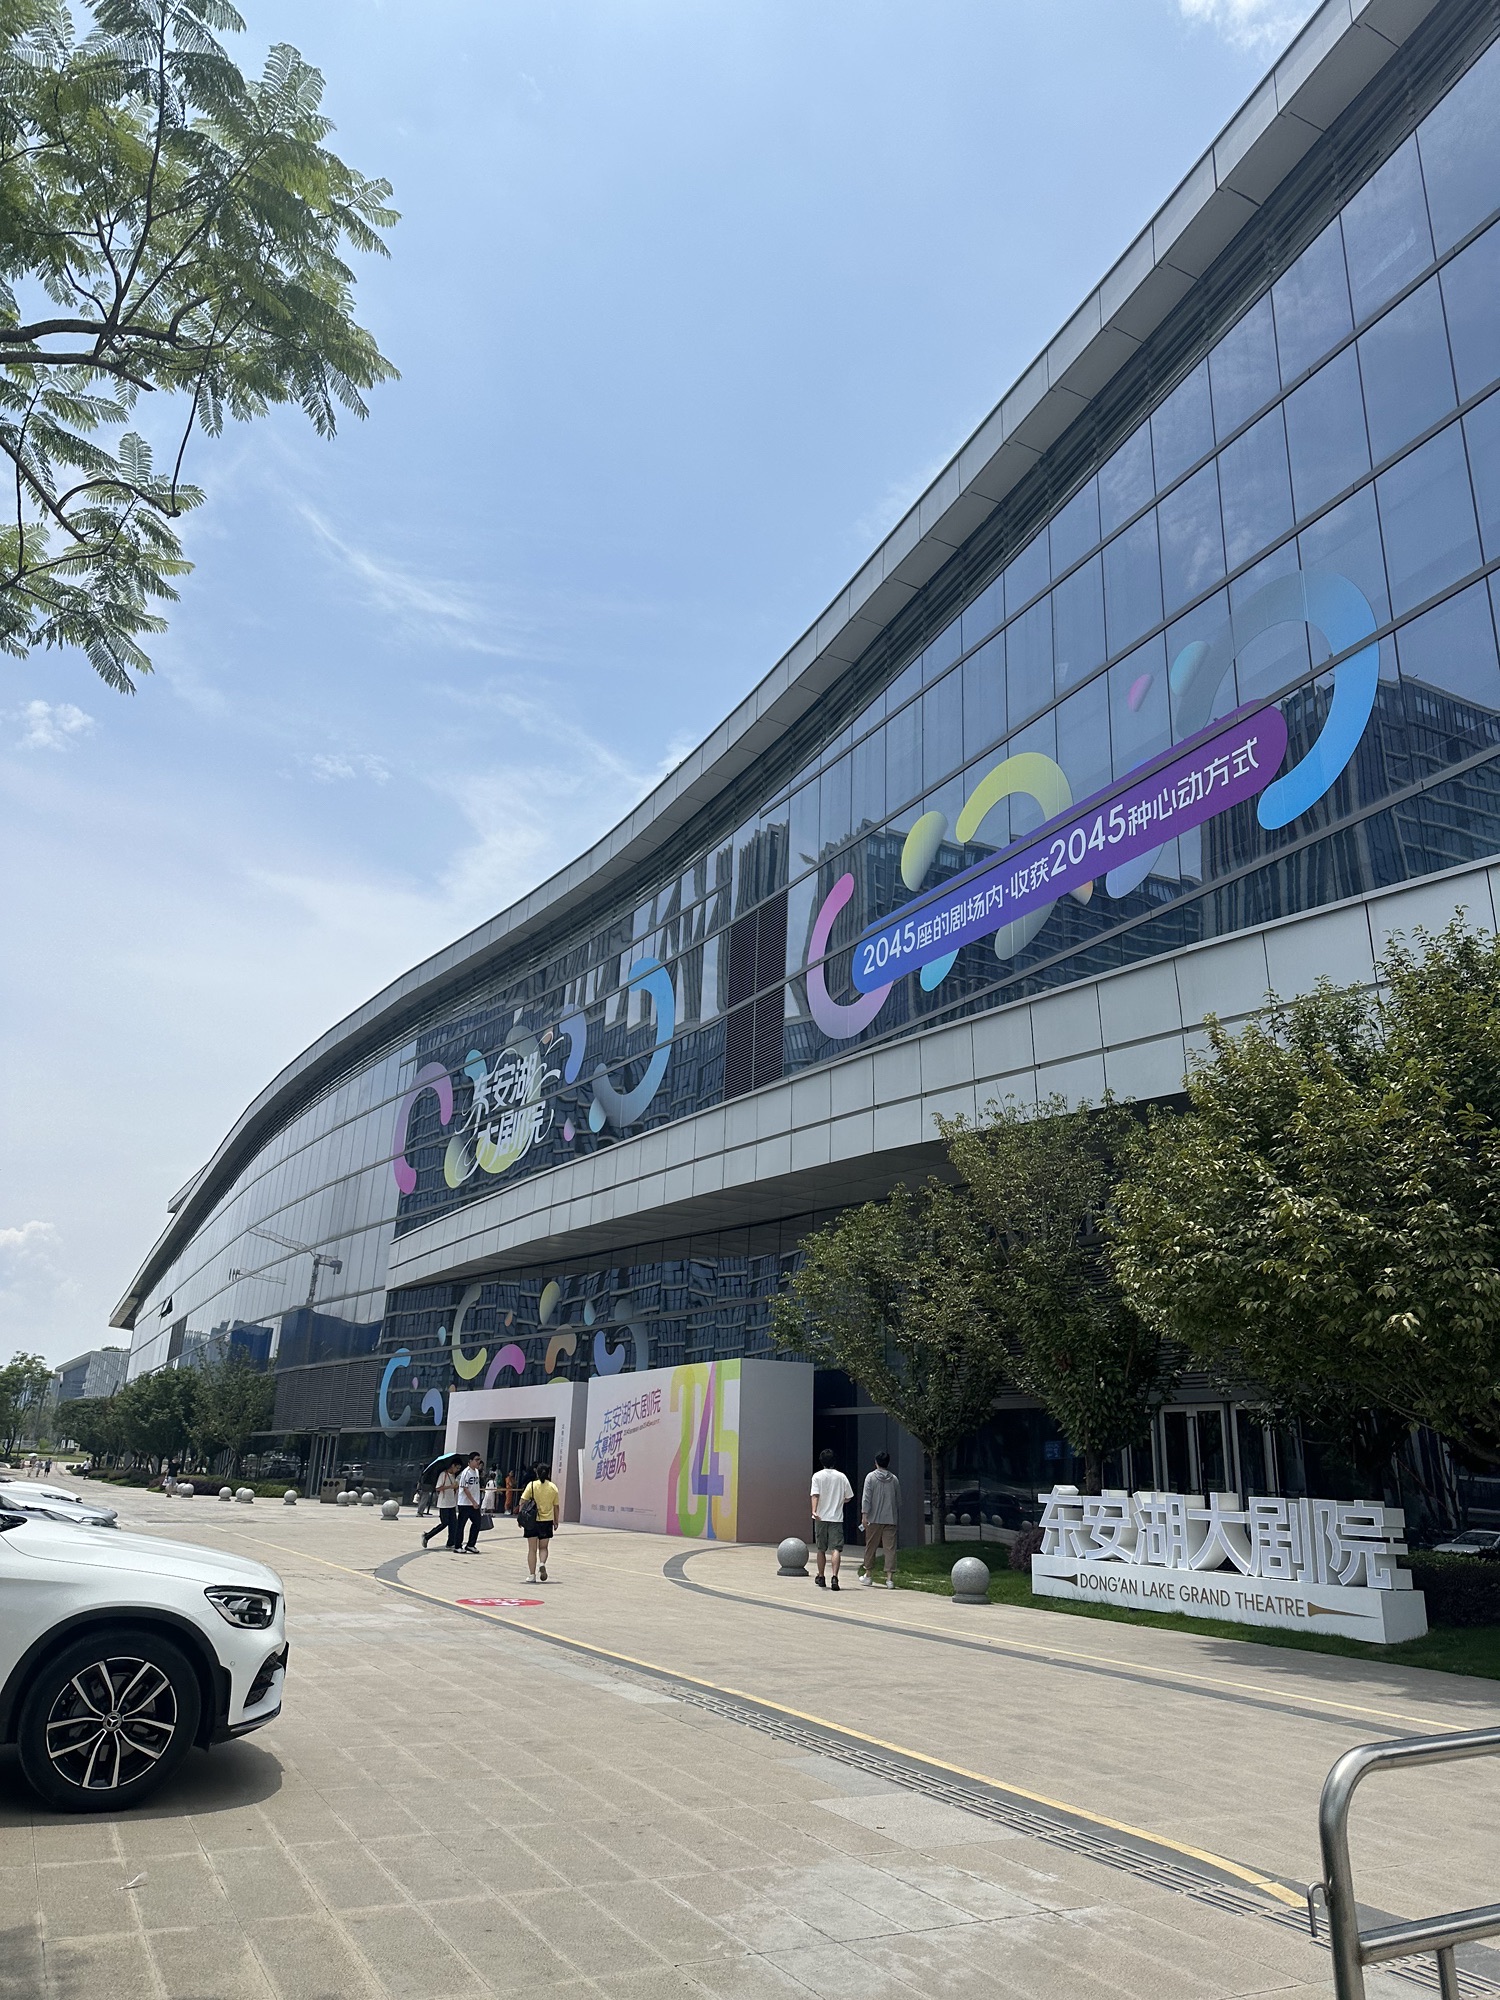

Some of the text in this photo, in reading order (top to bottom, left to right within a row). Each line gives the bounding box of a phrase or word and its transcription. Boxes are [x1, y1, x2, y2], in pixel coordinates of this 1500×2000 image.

[602, 1388, 662, 1434] 东安湖大剧院
[1037, 1485, 1396, 1590] 东安湖大剧院
[1079, 1572, 1306, 1618] DONG'AN LAKE GRAND THEATRE
